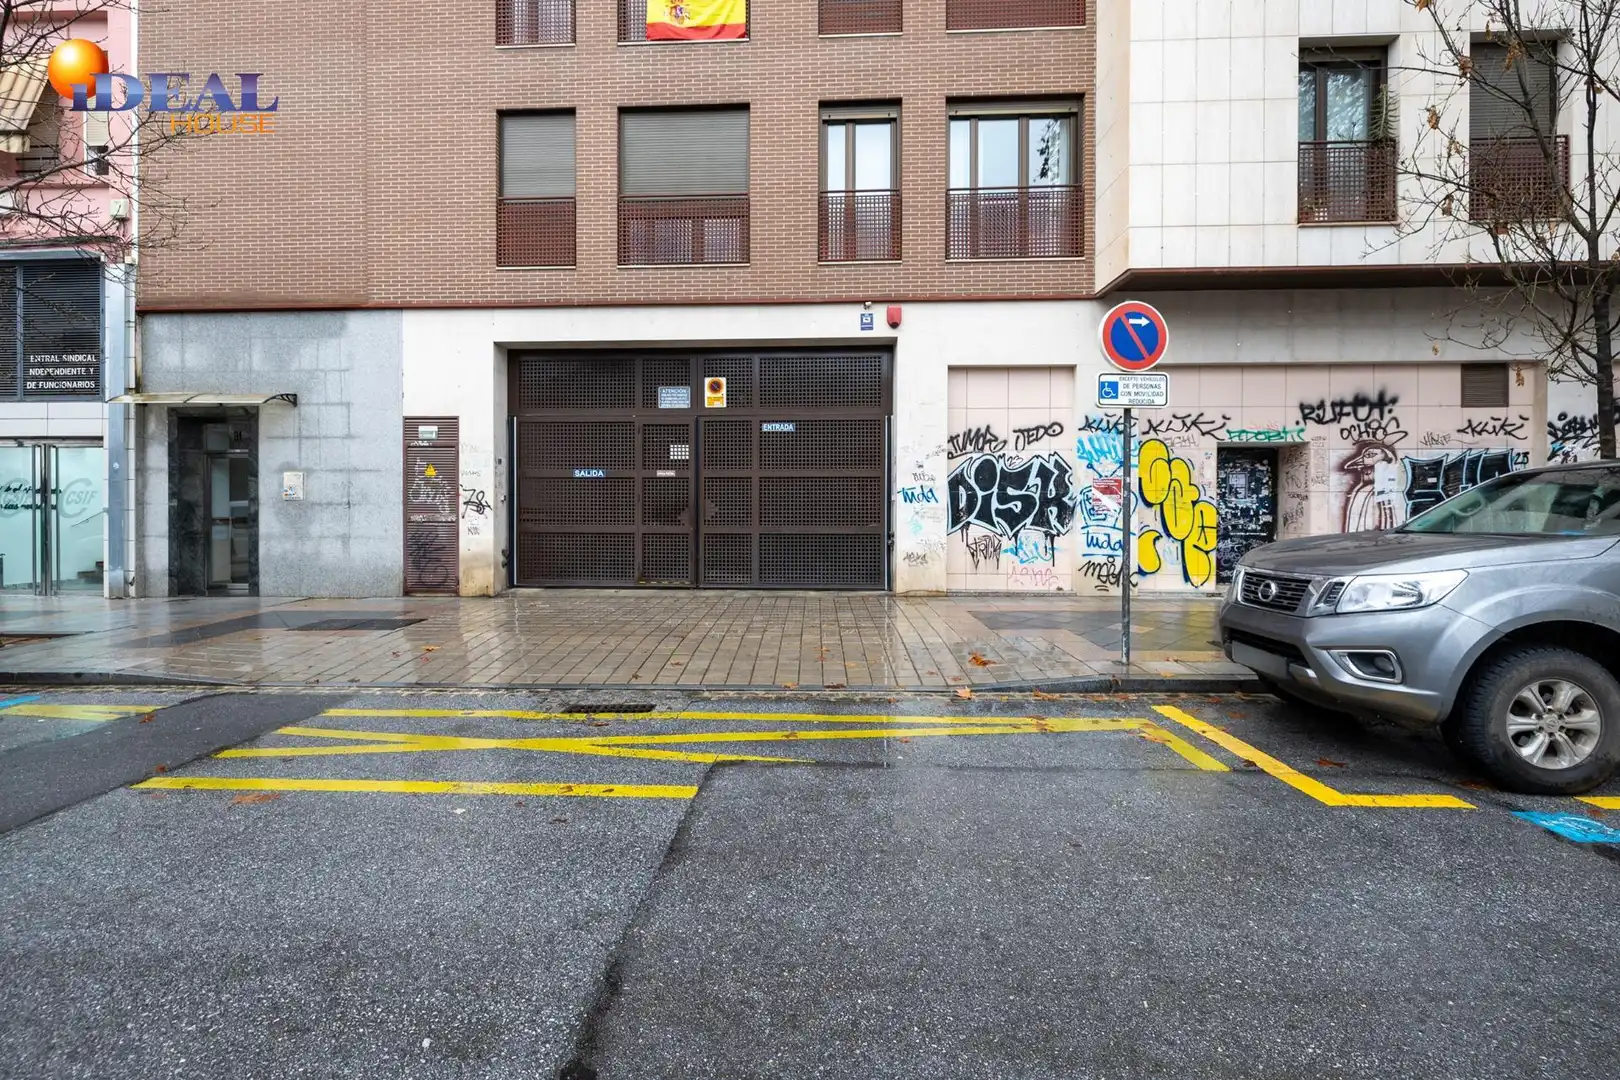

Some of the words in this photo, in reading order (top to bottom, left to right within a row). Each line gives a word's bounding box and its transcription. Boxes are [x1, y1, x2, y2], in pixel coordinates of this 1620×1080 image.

[62, 354, 97, 362] SINDICAL
[39, 381, 95, 389] FUNCIONARIOS
[763, 423, 794, 431] ENTRADA
[574, 469, 604, 477] SALIDA
[66, 490, 98, 505] CSIF
